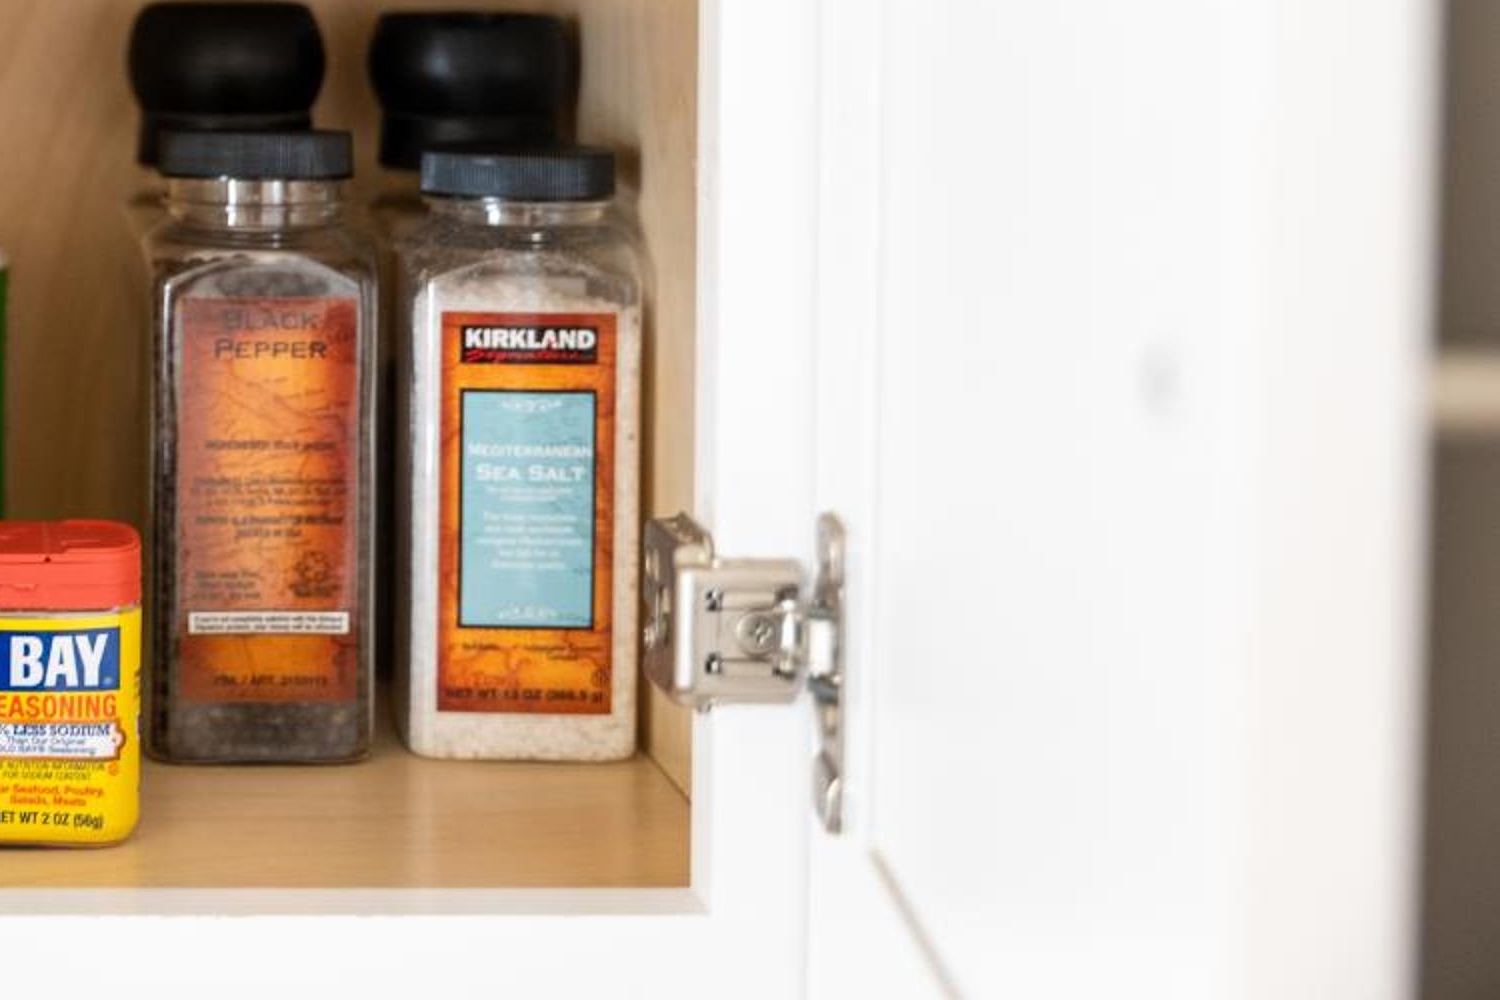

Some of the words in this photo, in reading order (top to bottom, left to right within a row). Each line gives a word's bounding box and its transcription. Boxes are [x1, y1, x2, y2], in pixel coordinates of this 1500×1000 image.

[213, 337, 329, 359] PEPPER
[465, 327, 596, 349] KIRKLAND
[476, 463, 521, 481] SEA
[528, 464, 584, 482] SALT
[10, 634, 108, 687] BAY
[13, 724, 46, 736] LESS
[50, 724, 110, 736] SODIUM
[19, 812, 38, 824] WT
[42, 812, 50, 825] 2
[53, 812, 70, 826] OZ
[74, 813, 104, 829] (56g)
